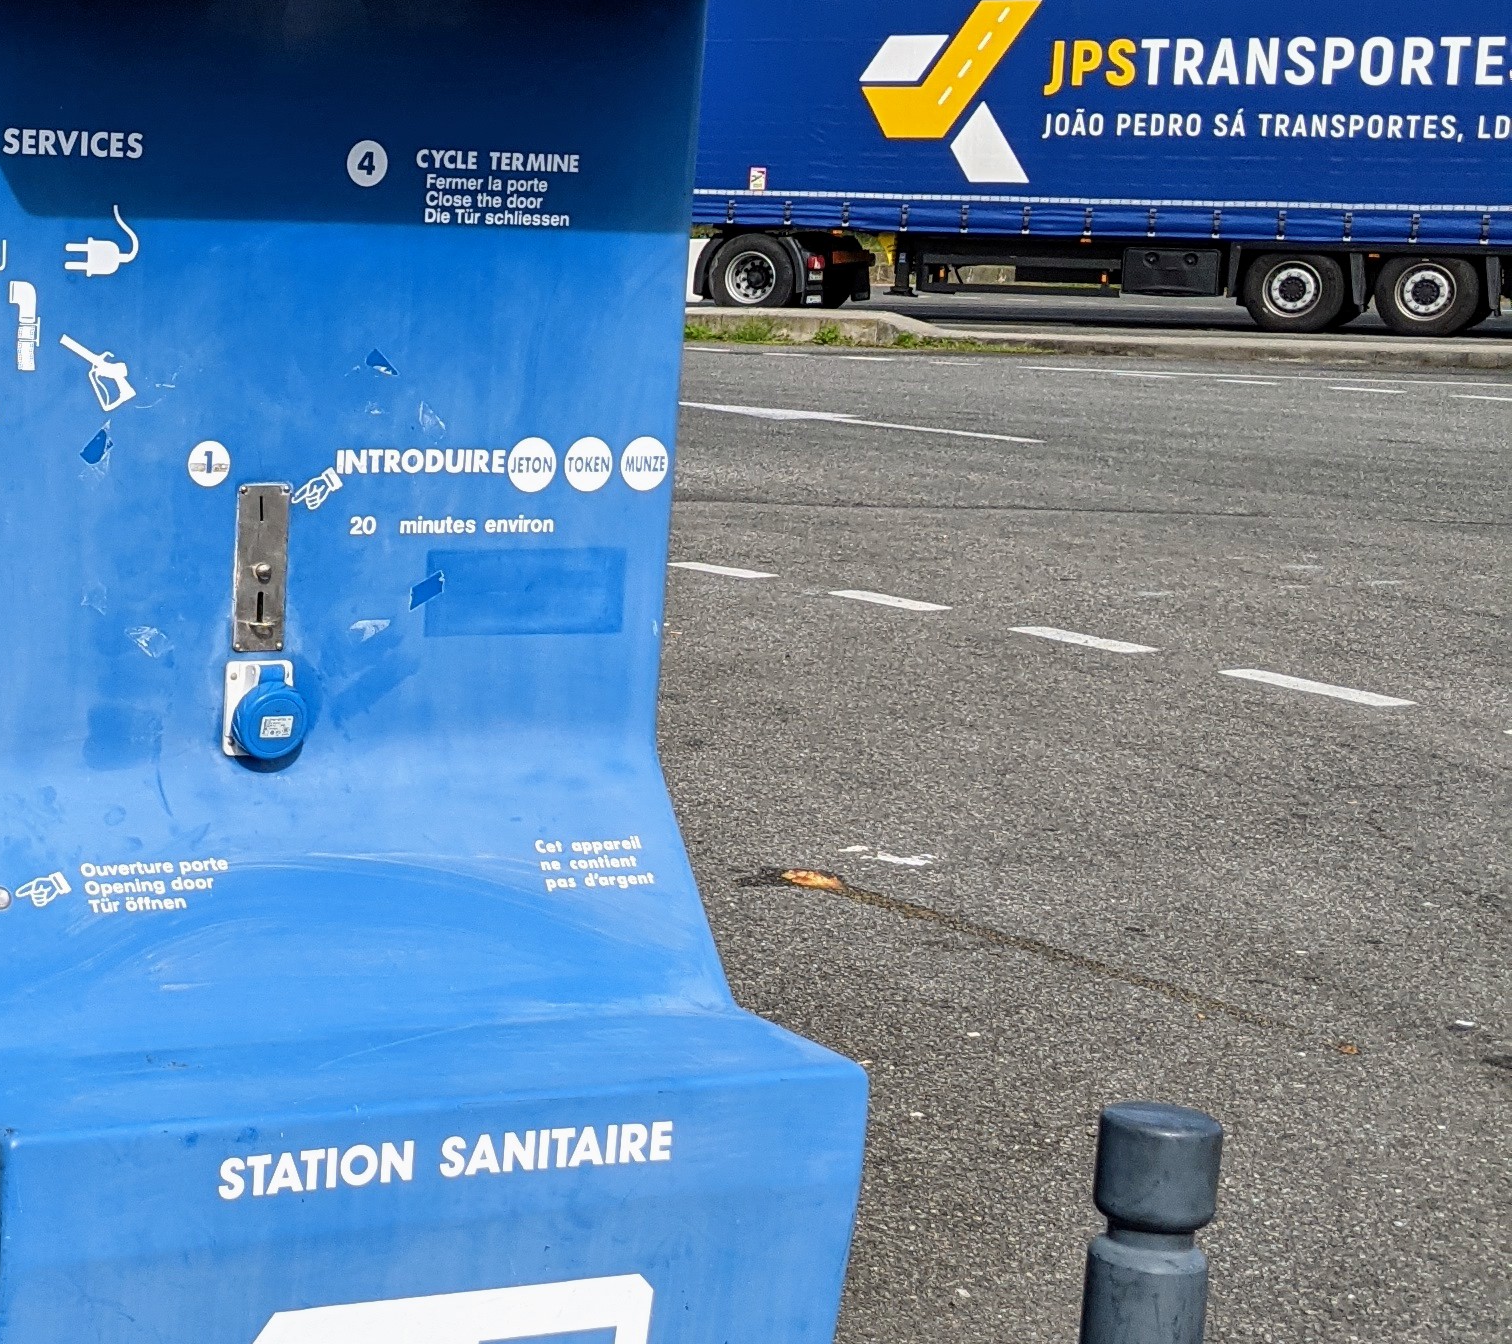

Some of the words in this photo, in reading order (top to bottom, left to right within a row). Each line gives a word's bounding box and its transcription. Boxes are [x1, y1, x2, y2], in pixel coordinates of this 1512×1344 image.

[1043, 35, 1512, 96] JPSTRANSPORTE
[1042, 108, 1105, 139] JOÃO
[1116, 112, 1202, 138] PEDRO
[1213, 108, 1247, 138] SÁ
[1258, 112, 1466, 143] TRANSPORTES,
[2, 128, 144, 158] SERVICES
[356, 150, 376, 176] 4
[416, 149, 478, 170] CYCLE
[489, 151, 580, 173] TERMINE
[426, 174, 483, 191] Fermer
[488, 175, 502, 192] la
[506, 177, 548, 195] porte
[425, 191, 472, 208] Close
[476, 192, 502, 208] the
[506, 194, 543, 209] door
[424, 209, 450, 224] Die
[454, 208, 480, 225] Tür
[485, 210, 570, 227] schliessen
[204, 450, 213, 474] 1
[336, 448, 506, 474] INTRODUIRE
[510, 455, 553, 474] JETON
[567, 455, 611, 474] TOKEN
[349, 516, 377, 535] 20
[399, 516, 476, 535] minutes
[484, 515, 554, 534] environ
[534, 839, 563, 854] Cet
[571, 835, 642, 854] appareil
[80, 859, 175, 878] Ouverture
[179, 856, 229, 876] porte
[540, 859, 561, 871] ne
[569, 855, 637, 870] contient
[84, 878, 166, 897] Opening
[171, 876, 214, 892] door
[545, 876, 577, 892] pas
[584, 872, 655, 889] d'argent
[88, 898, 119, 914] Tür
[125, 896, 187, 912] öffnen
[218, 1140, 415, 1200] STATION
[439, 1121, 673, 1178] SANITAIRE
